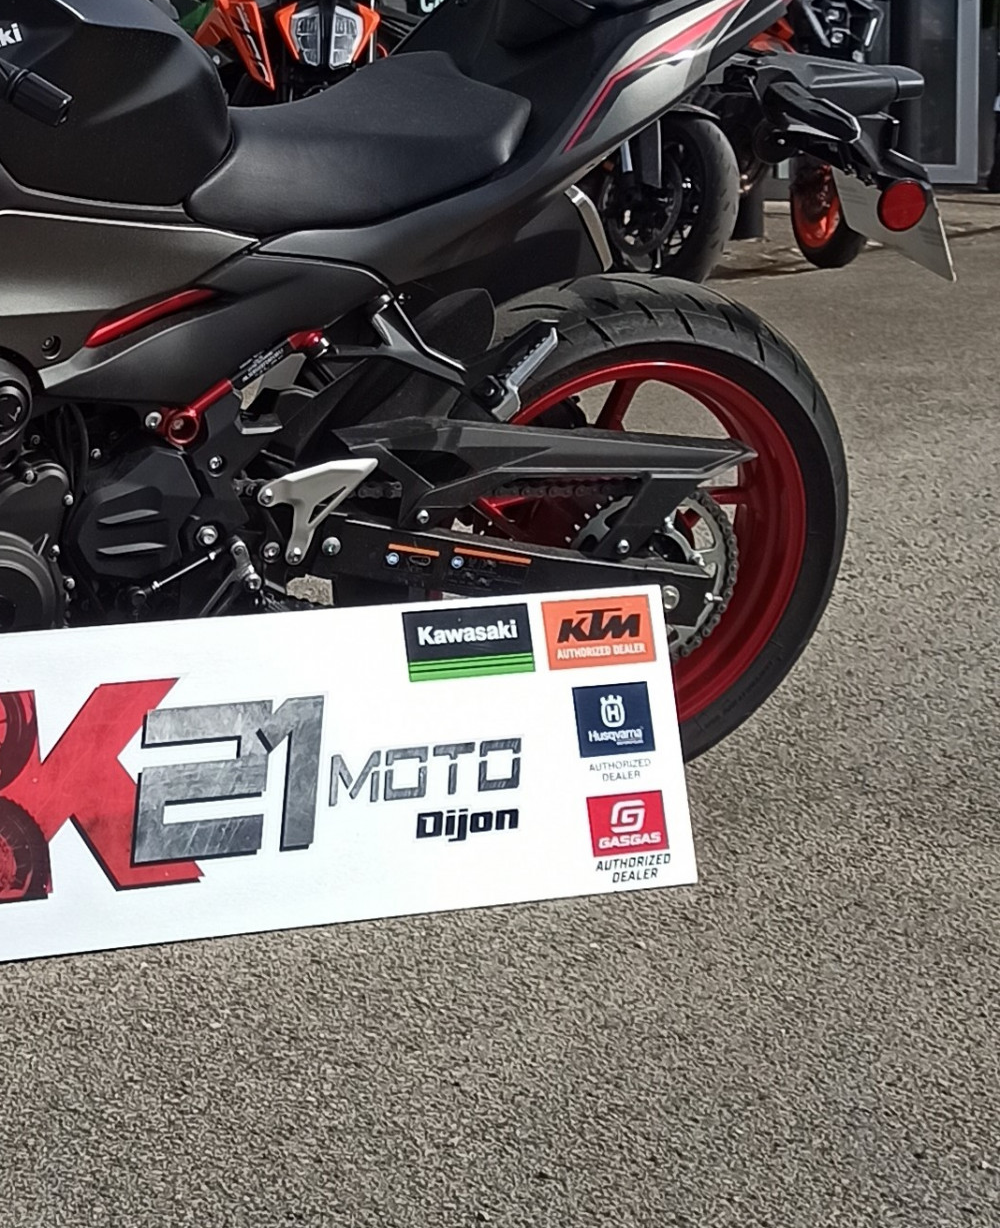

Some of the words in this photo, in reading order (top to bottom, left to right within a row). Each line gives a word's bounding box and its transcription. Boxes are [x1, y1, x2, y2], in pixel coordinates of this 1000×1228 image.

[417, 619, 518, 646] Kawasaki
[557, 607, 641, 643] KTM
[557, 645, 612, 660] AUTHORIZED
[612, 642, 647, 655] DEALER
[588, 728, 643, 743] Husqvarna
[328, 737, 522, 807] MOTO
[589, 758, 652, 772] AUTHORIZED
[602, 770, 641, 782] DEALER
[415, 808, 519, 842] Dijon
[598, 831, 662, 849] GASGAS
[595, 853, 671, 872] AUTHORIZED
[612, 867, 658, 884] DEALER
